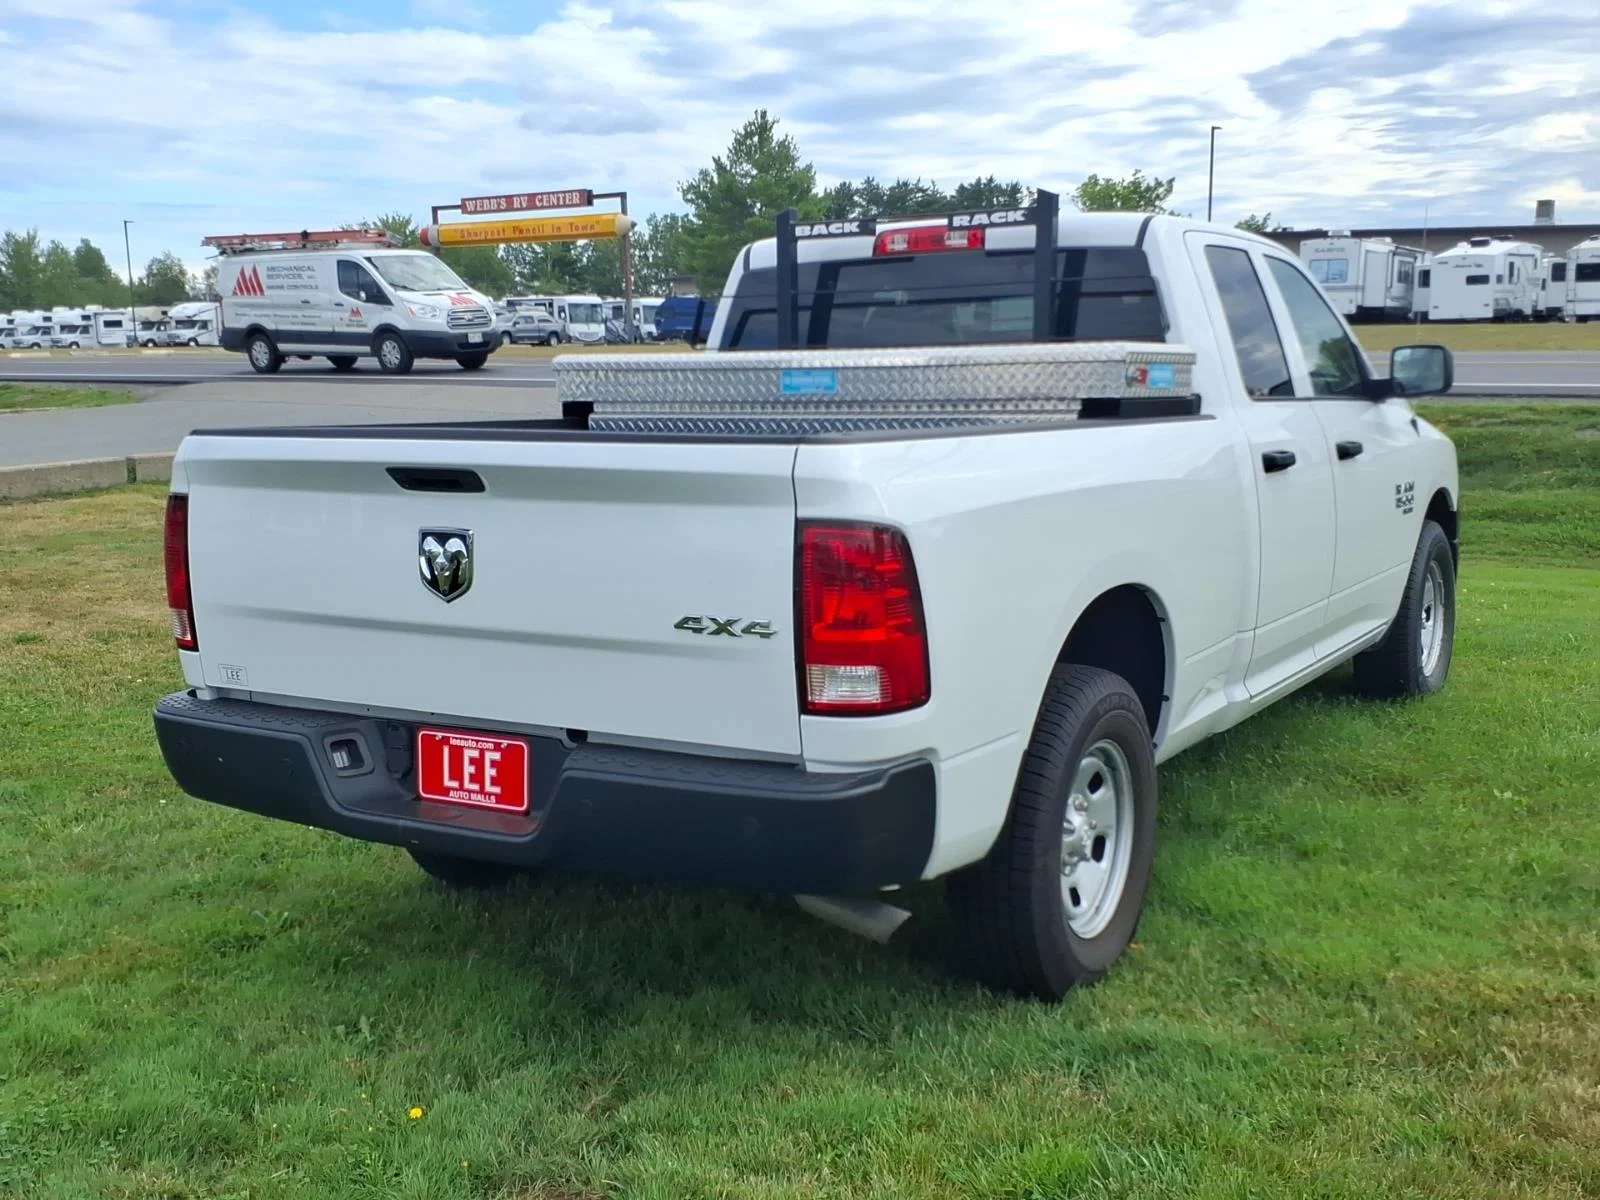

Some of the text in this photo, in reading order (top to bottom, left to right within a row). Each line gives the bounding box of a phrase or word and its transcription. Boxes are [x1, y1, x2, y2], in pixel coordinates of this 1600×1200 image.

[465, 192, 581, 213] WEBB'S RV CENTER
[512, 222, 545, 236] Pencil
[795, 209, 1026, 237] BACK RACK
[266, 265, 316, 273] MECHANICAL
[673, 616, 779, 639] 4X4
[226, 670, 241, 681] LEE
[449, 738, 494, 750] leeauto.com
[442, 745, 502, 794] LEE
[448, 790, 496, 804] AUTO MALLS
